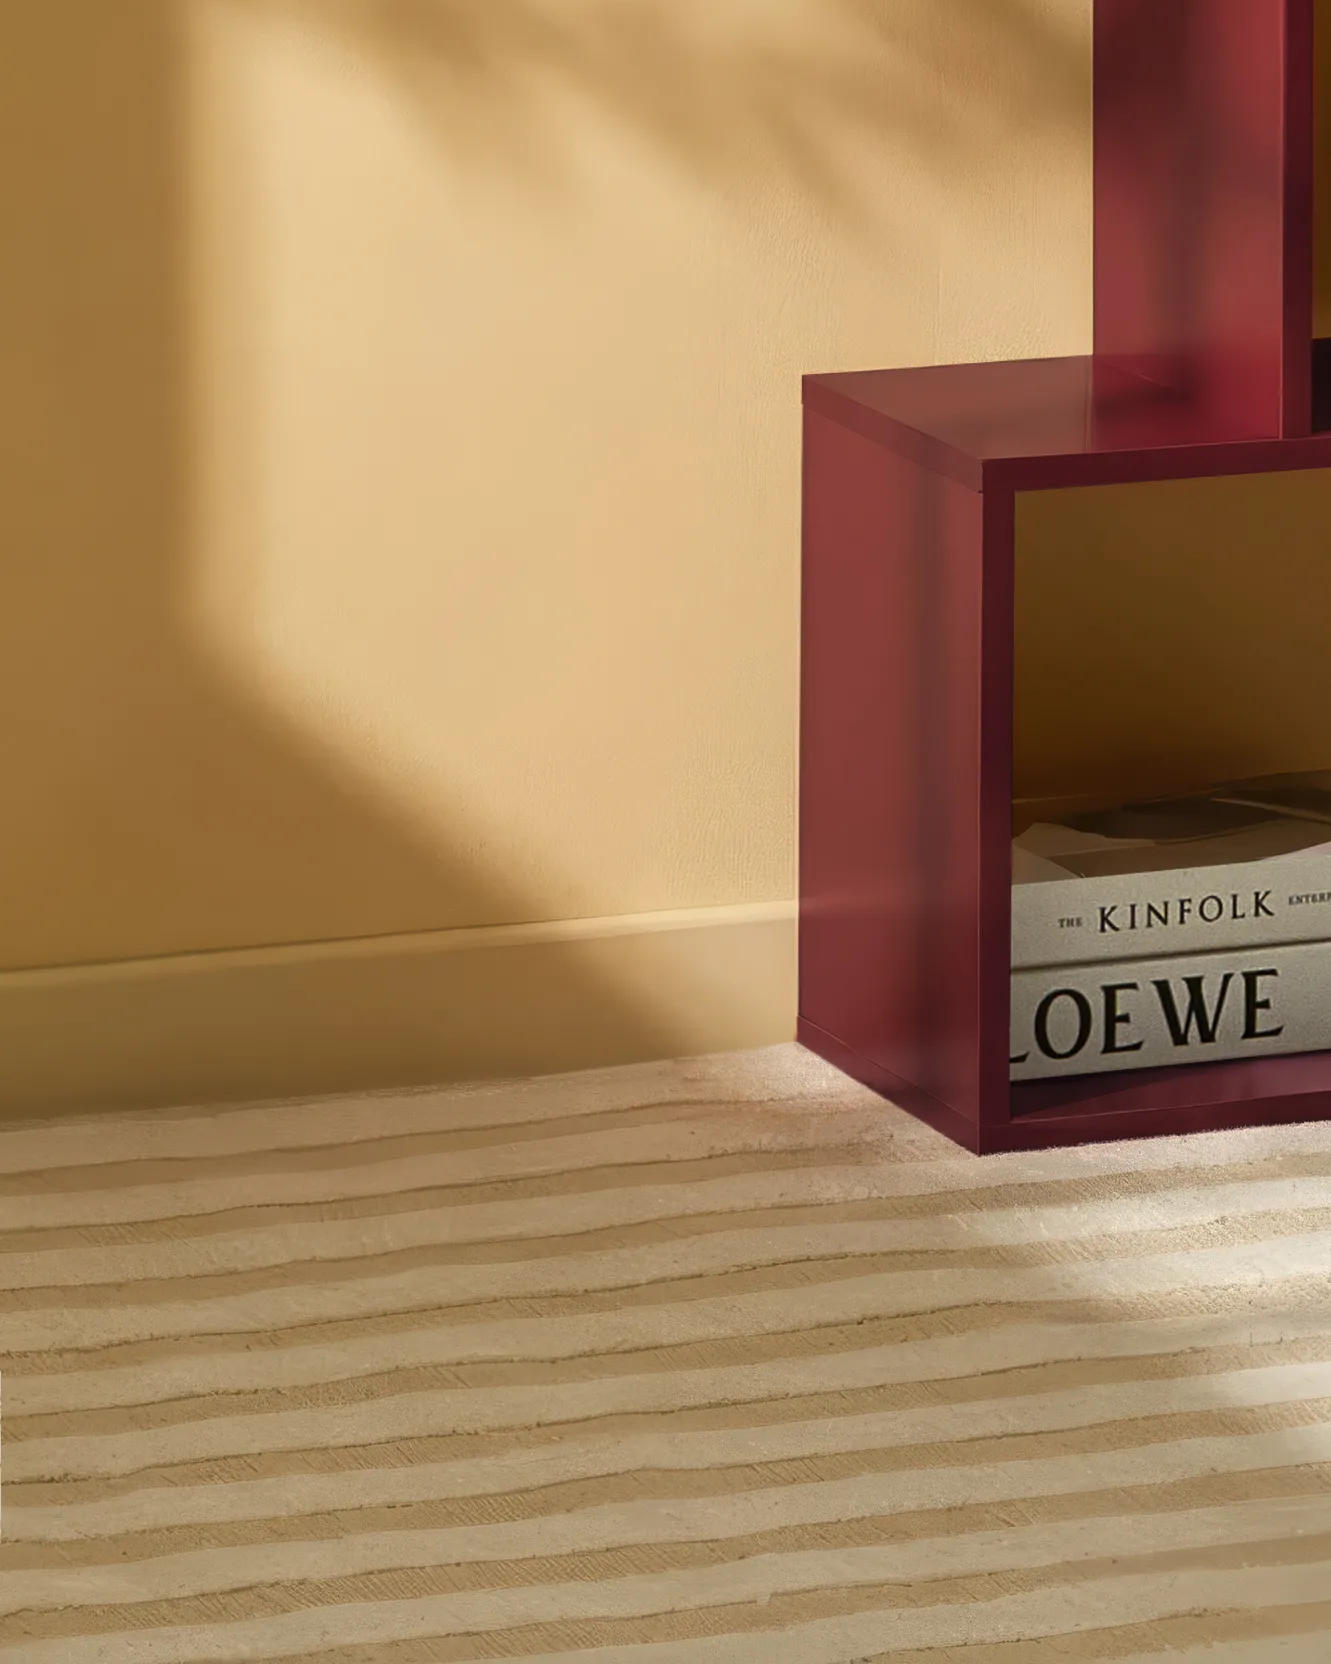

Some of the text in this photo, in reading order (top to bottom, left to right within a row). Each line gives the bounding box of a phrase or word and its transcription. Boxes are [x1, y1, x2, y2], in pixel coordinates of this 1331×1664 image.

[1058, 916, 1083, 928] THE
[1099, 890, 1275, 933] KINFOLK
[1009, 968, 1285, 1064] OEWE
